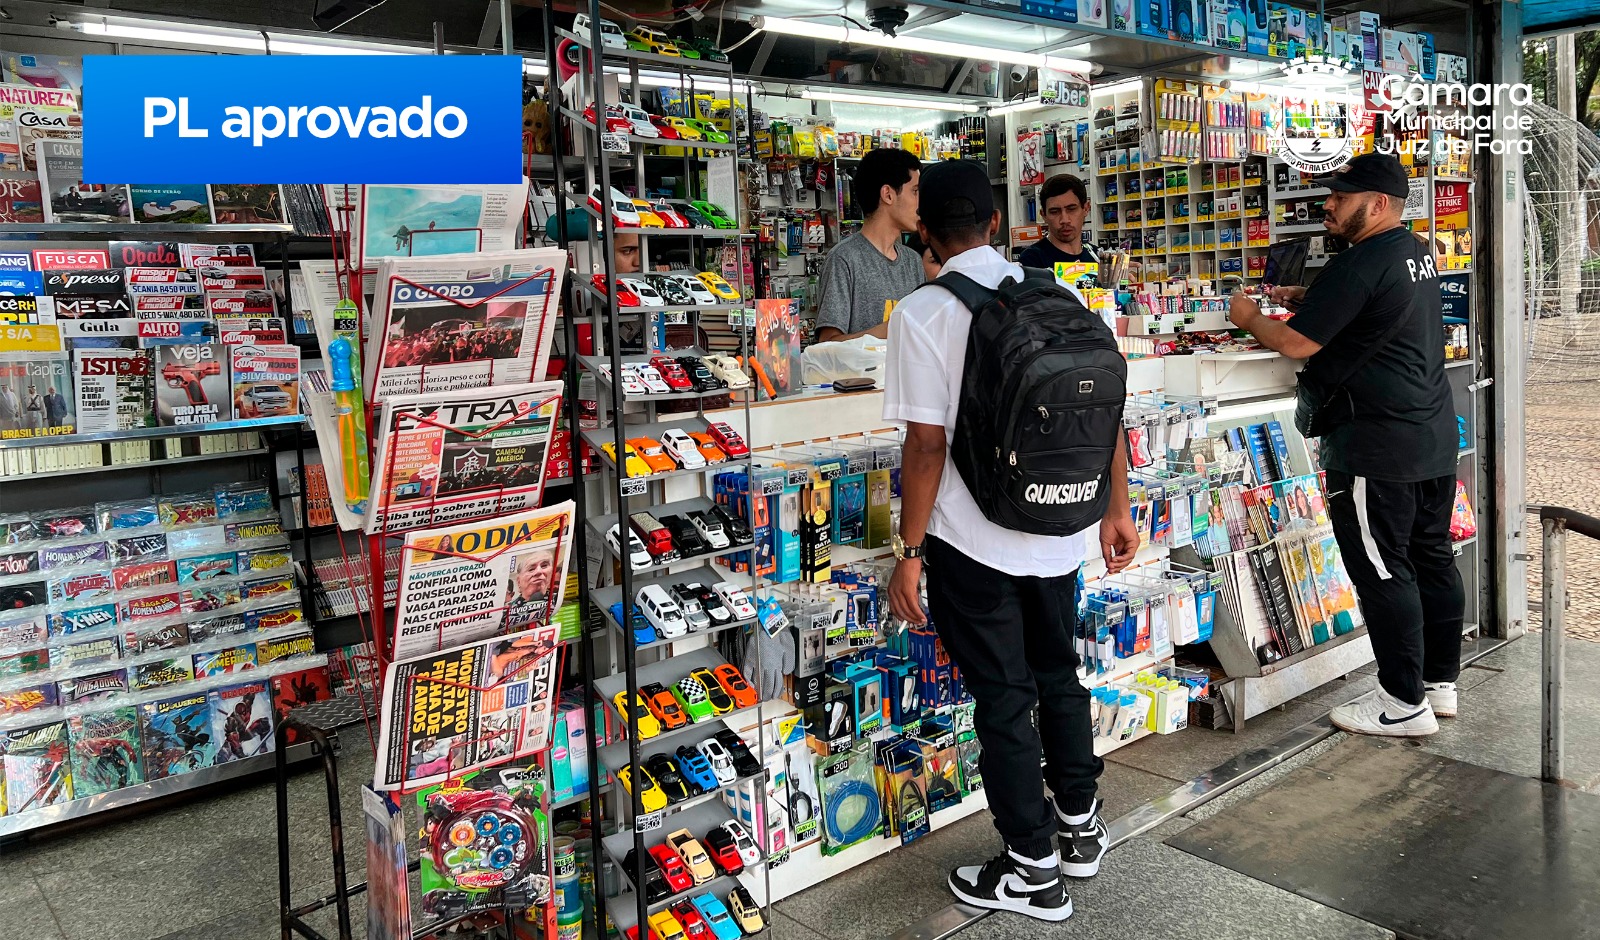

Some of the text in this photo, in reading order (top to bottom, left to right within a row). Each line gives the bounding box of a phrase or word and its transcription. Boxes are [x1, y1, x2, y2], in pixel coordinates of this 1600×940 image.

[20, 112, 66, 127] Casa
[53, 144, 75, 156] CASA
[1437, 199, 1462, 207] STRIKE
[0, 258, 27, 266] ANG
[45, 256, 99, 264] FUSCA
[121, 245, 177, 266] Opala
[133, 269, 175, 277] transporte
[48, 273, 120, 289] espresso
[204, 277, 236, 287] QUATRO
[132, 285, 158, 293] SCANIA
[179, 285, 197, 293] PLUS
[397, 285, 474, 300] O GLOBO
[56, 300, 130, 313] MESA
[212, 299, 245, 309] QUATRO
[137, 311, 157, 319] IVECO
[79, 321, 120, 333] Gula
[142, 322, 179, 334] AUTO
[7, 328, 33, 341] S/A
[222, 331, 256, 342] QUATRO
[170, 344, 214, 363] veja
[235, 358, 268, 369] QUATRO
[240, 372, 292, 381] SILVERADO
[380, 377, 402, 387] Milei
[404, 375, 448, 386] desvloriza
[449, 374, 467, 384] peso
[379, 386, 420, 397] subsídios,
[172, 404, 218, 416] TIRO PELA
[174, 414, 218, 425] CULATRA
[2, 425, 74, 439] BRASIL E A OPEP
[521, 425, 548, 434] Mundial
[1025, 479, 1099, 505] QUIKSILVER
[406, 507, 439, 517] tudo
[441, 503, 477, 513] sobre
[373, 520, 419, 532] rgras
[420, 517, 433, 526] do
[434, 508, 492, 523] Desenrola
[238, 524, 281, 538] VINGADORES
[815, 523, 830, 533] SPEED
[456, 523, 532, 553] O DIA
[819, 530, 828, 541] &
[814, 539, 831, 549] DATA
[408, 568, 492, 591] CONFIRA COMO
[409, 573, 426, 581] NÃO
[427, 569, 451, 578] PERCA
[406, 578, 498, 603] CONSEGUIR UMA
[132, 601, 178, 615] HOMEM-ARANHA
[406, 589, 497, 614] VAGA PARA 2024
[403, 600, 494, 625] NAS CRECHES DA
[66, 610, 113, 632] X-MEN
[215, 623, 246, 635] NEGRA
[401, 623, 432, 637] REDE
[441, 661, 458, 728] MATA A
[454, 649, 475, 733] MONSTRO
[412, 685, 428, 733] ANOS
[426, 711, 440, 736] DE
